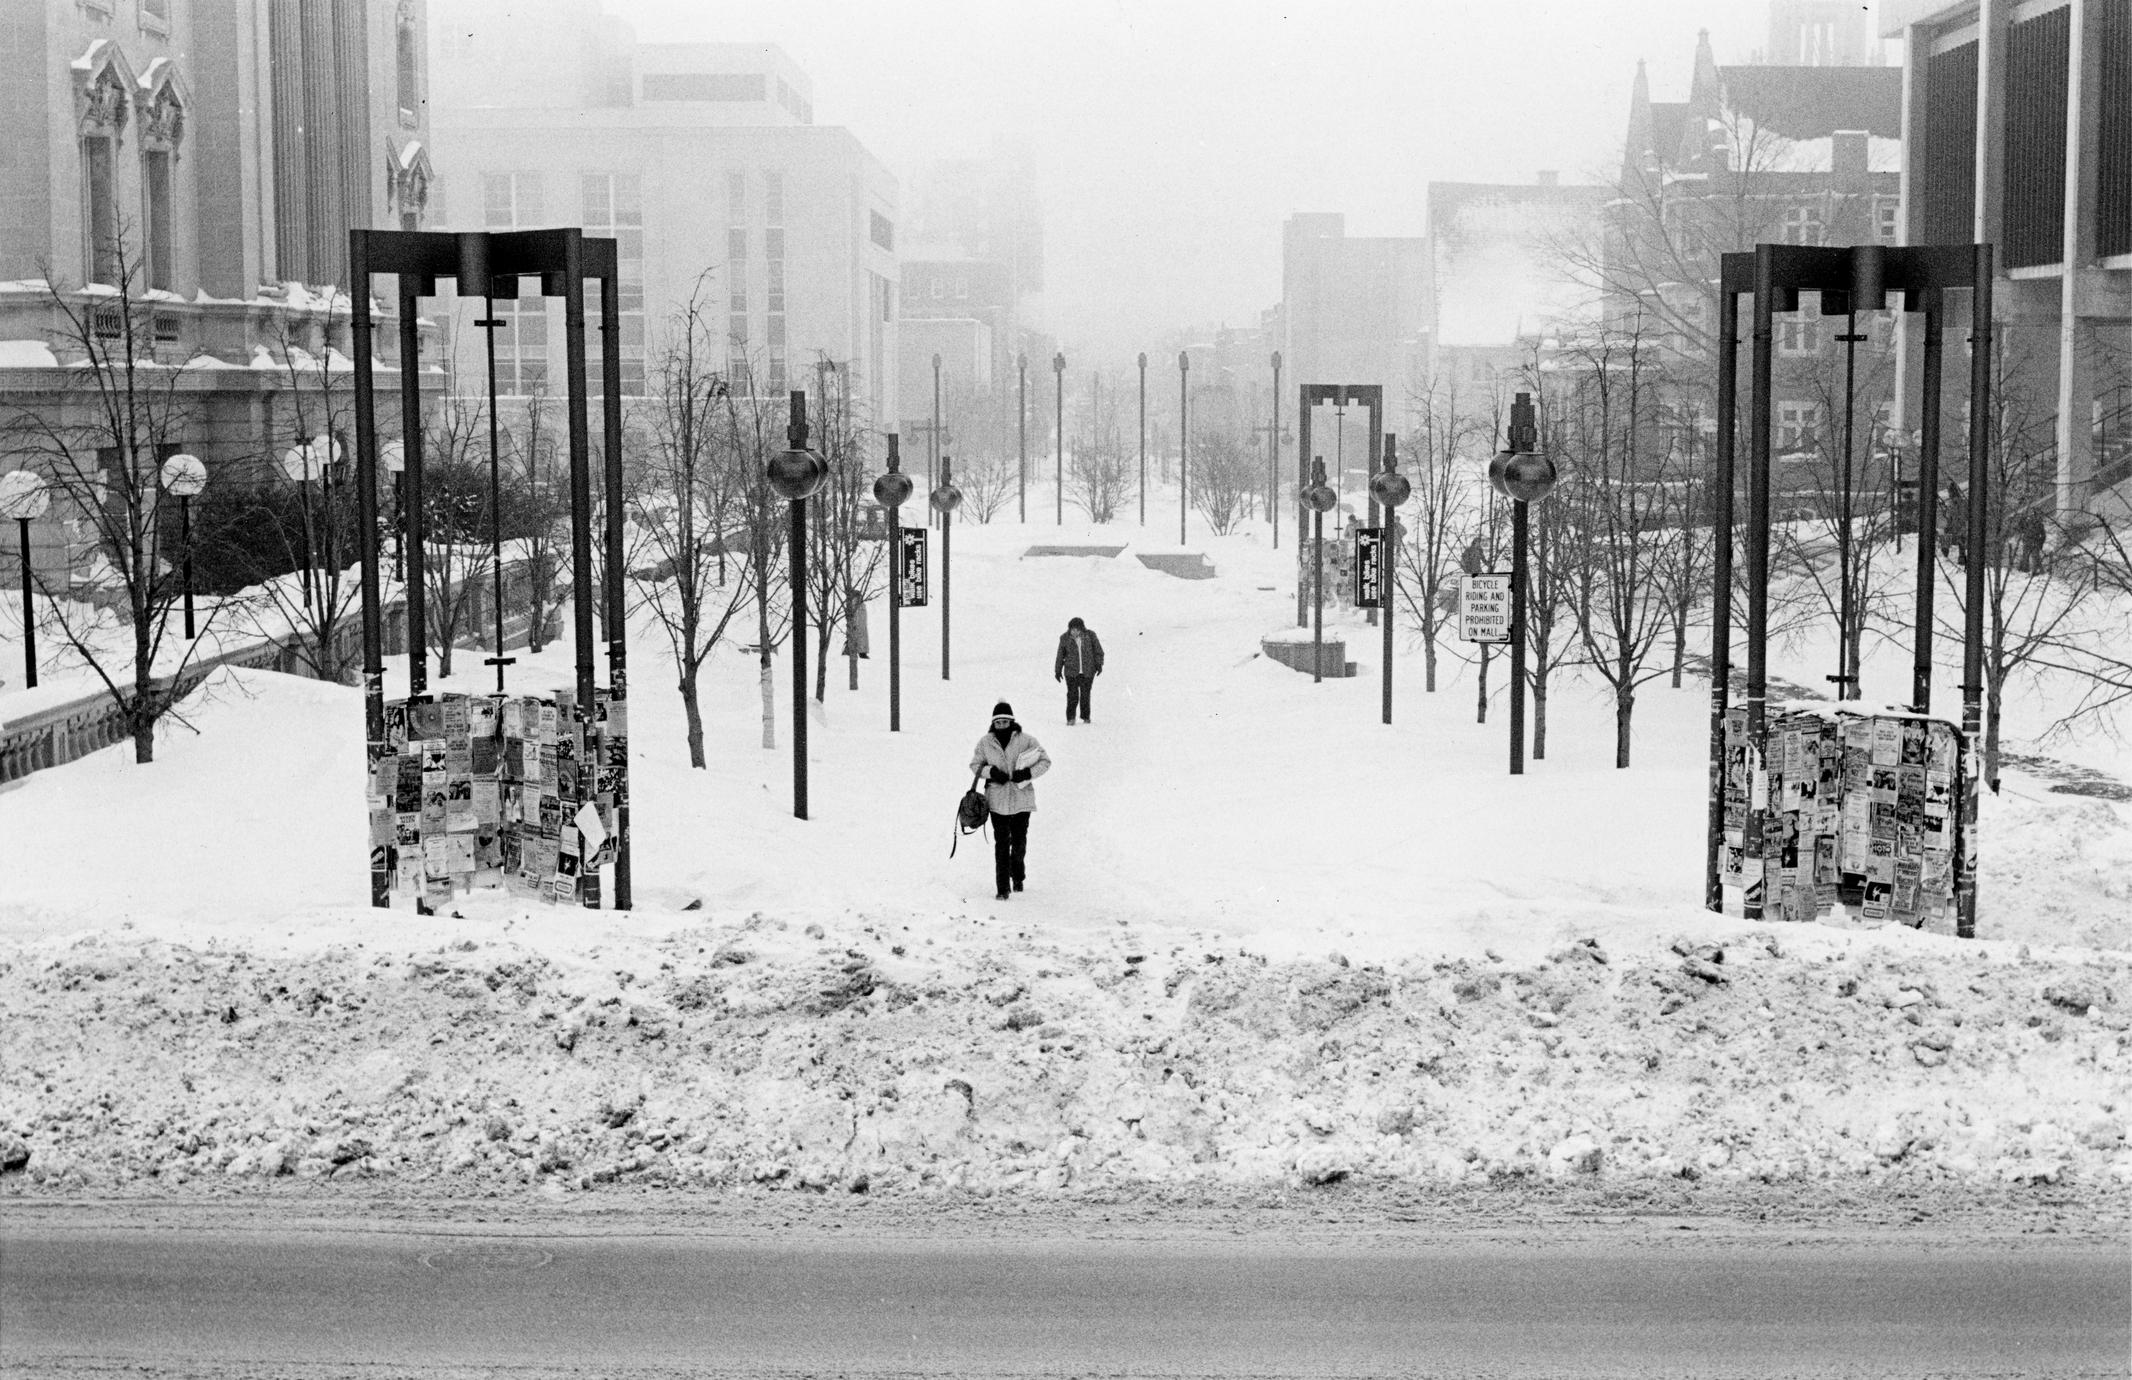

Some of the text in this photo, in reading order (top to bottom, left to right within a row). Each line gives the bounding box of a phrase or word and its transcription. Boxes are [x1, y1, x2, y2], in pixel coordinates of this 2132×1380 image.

[914, 544, 922, 565] racks
[908, 559, 916, 579] bikes
[1472, 580, 1499, 590] BICYCLE
[1465, 591, 1505, 601] RIDING AND
[1470, 603, 1500, 613] PARKING
[1465, 615, 1505, 625] PROHIBITED
[1468, 627, 1499, 637] ON MALL
